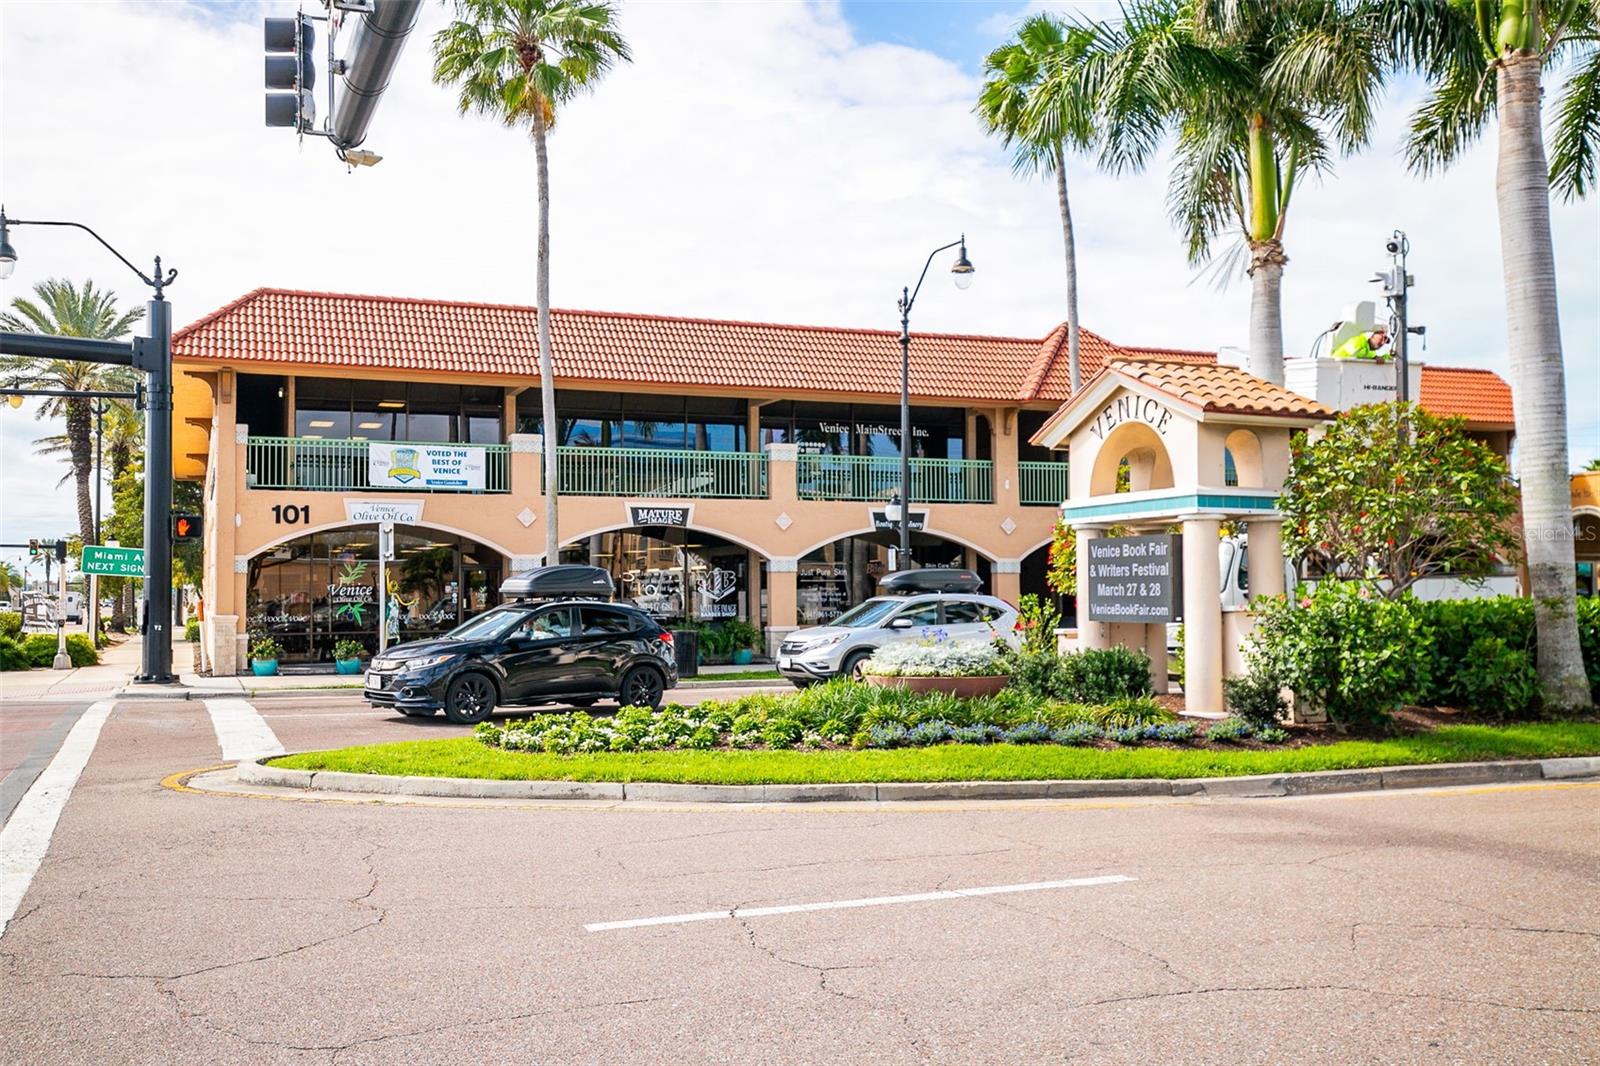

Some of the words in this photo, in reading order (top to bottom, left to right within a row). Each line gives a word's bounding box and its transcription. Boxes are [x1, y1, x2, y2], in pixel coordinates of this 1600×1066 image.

[1089, 395, 1173, 440] VENICE
[819, 422, 850, 434] Venice
[855, 423, 903, 437] MainStree
[912, 426, 930, 437] Inc.
[426, 450, 452, 458] VOTED
[432, 467, 461, 475] VENICE
[370, 503, 396, 513] Venice
[271, 504, 310, 524] 101
[353, 512, 379, 521] Olive
[382, 512, 398, 521] Oil
[400, 513, 415, 522] Co.
[637, 509, 683, 520] MATURE
[647, 517, 673, 525] IMAGE
[1091, 544, 1120, 558] Venice
[1122, 543, 1147, 557] Book
[1148, 542, 1168, 556] Fair
[94, 551, 128, 561] Miami
[87, 562, 115, 571] NEXT
[120, 564, 145, 573] SIGN
[1089, 564, 1096, 577] &
[1097, 564, 1130, 577] Writers
[1132, 562, 1169, 576] Festival
[327, 584, 373, 596] Venice
[1097, 583, 1125, 597] March
[1126, 583, 1138, 597] 27
[1139, 583, 1147, 597] &
[1149, 583, 1161, 597] 28
[1090, 603, 1169, 616] VeniceBookFair.com
